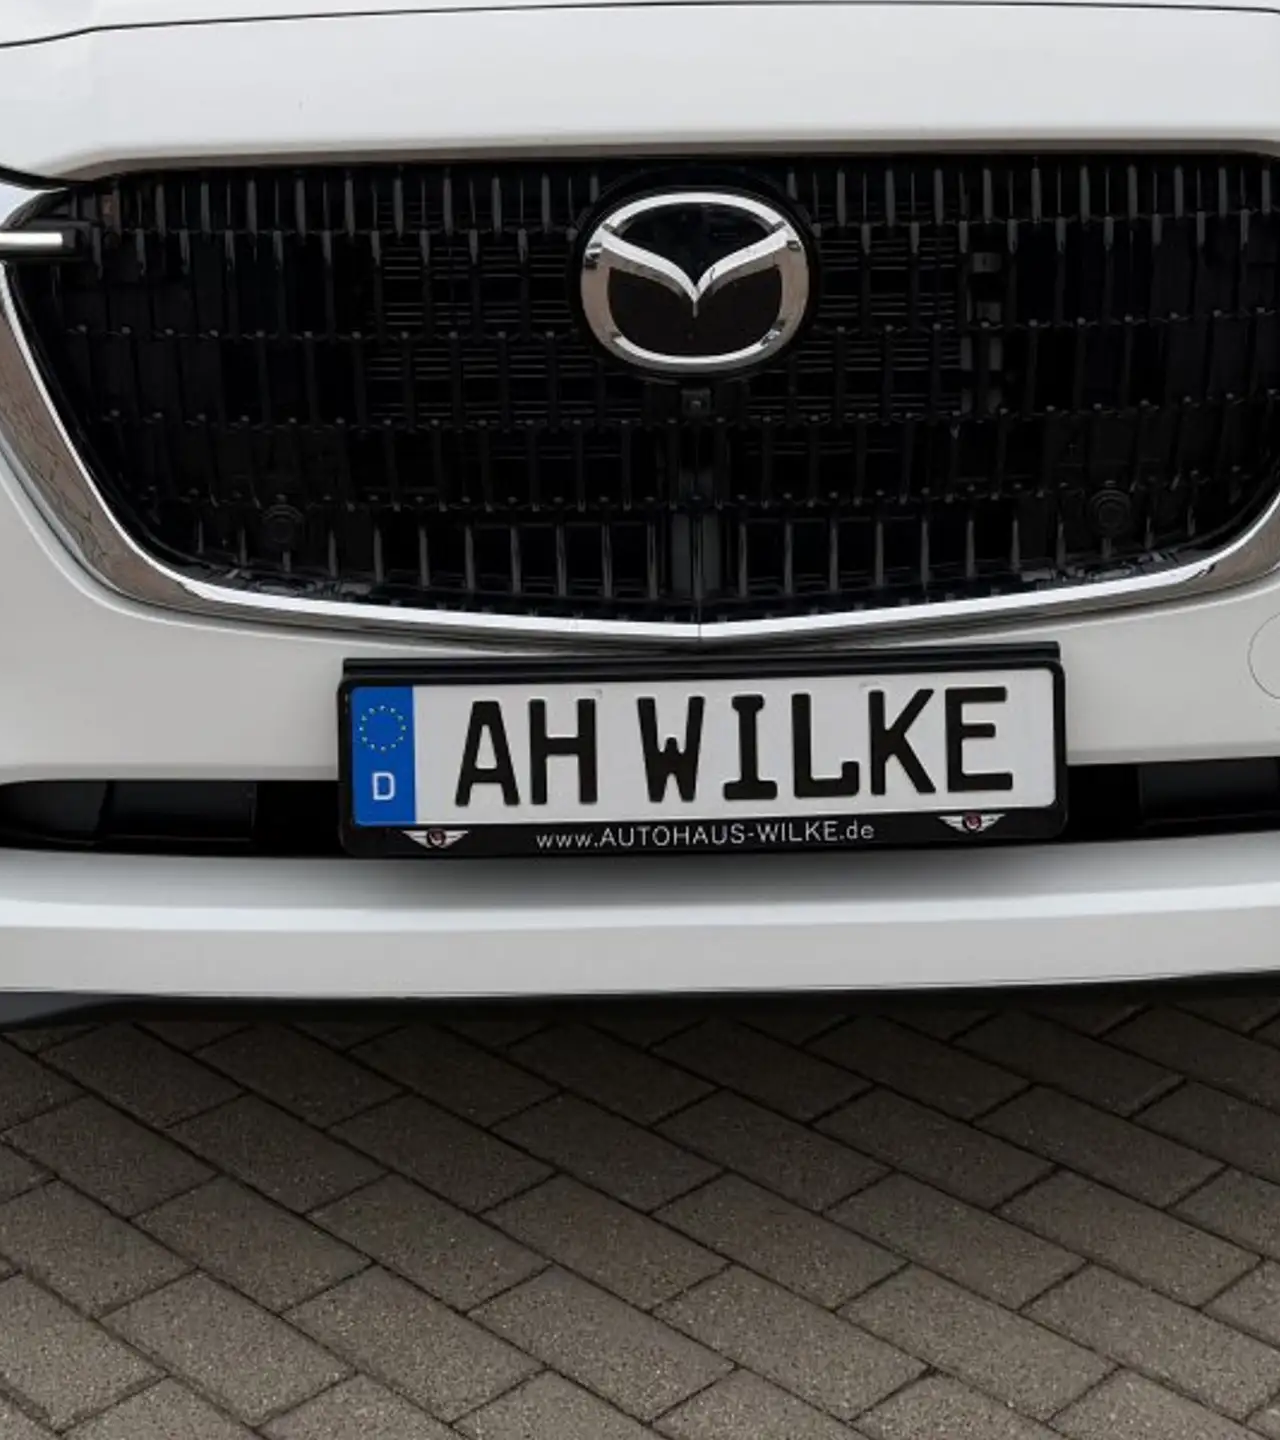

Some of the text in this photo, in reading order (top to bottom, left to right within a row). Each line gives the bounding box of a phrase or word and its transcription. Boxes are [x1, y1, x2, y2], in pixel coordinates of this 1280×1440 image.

[454, 685, 1014, 807] AH WILKE
[372, 771, 396, 801] D
[535, 819, 876, 849] www.AUTOHAUS-WILKE.de
